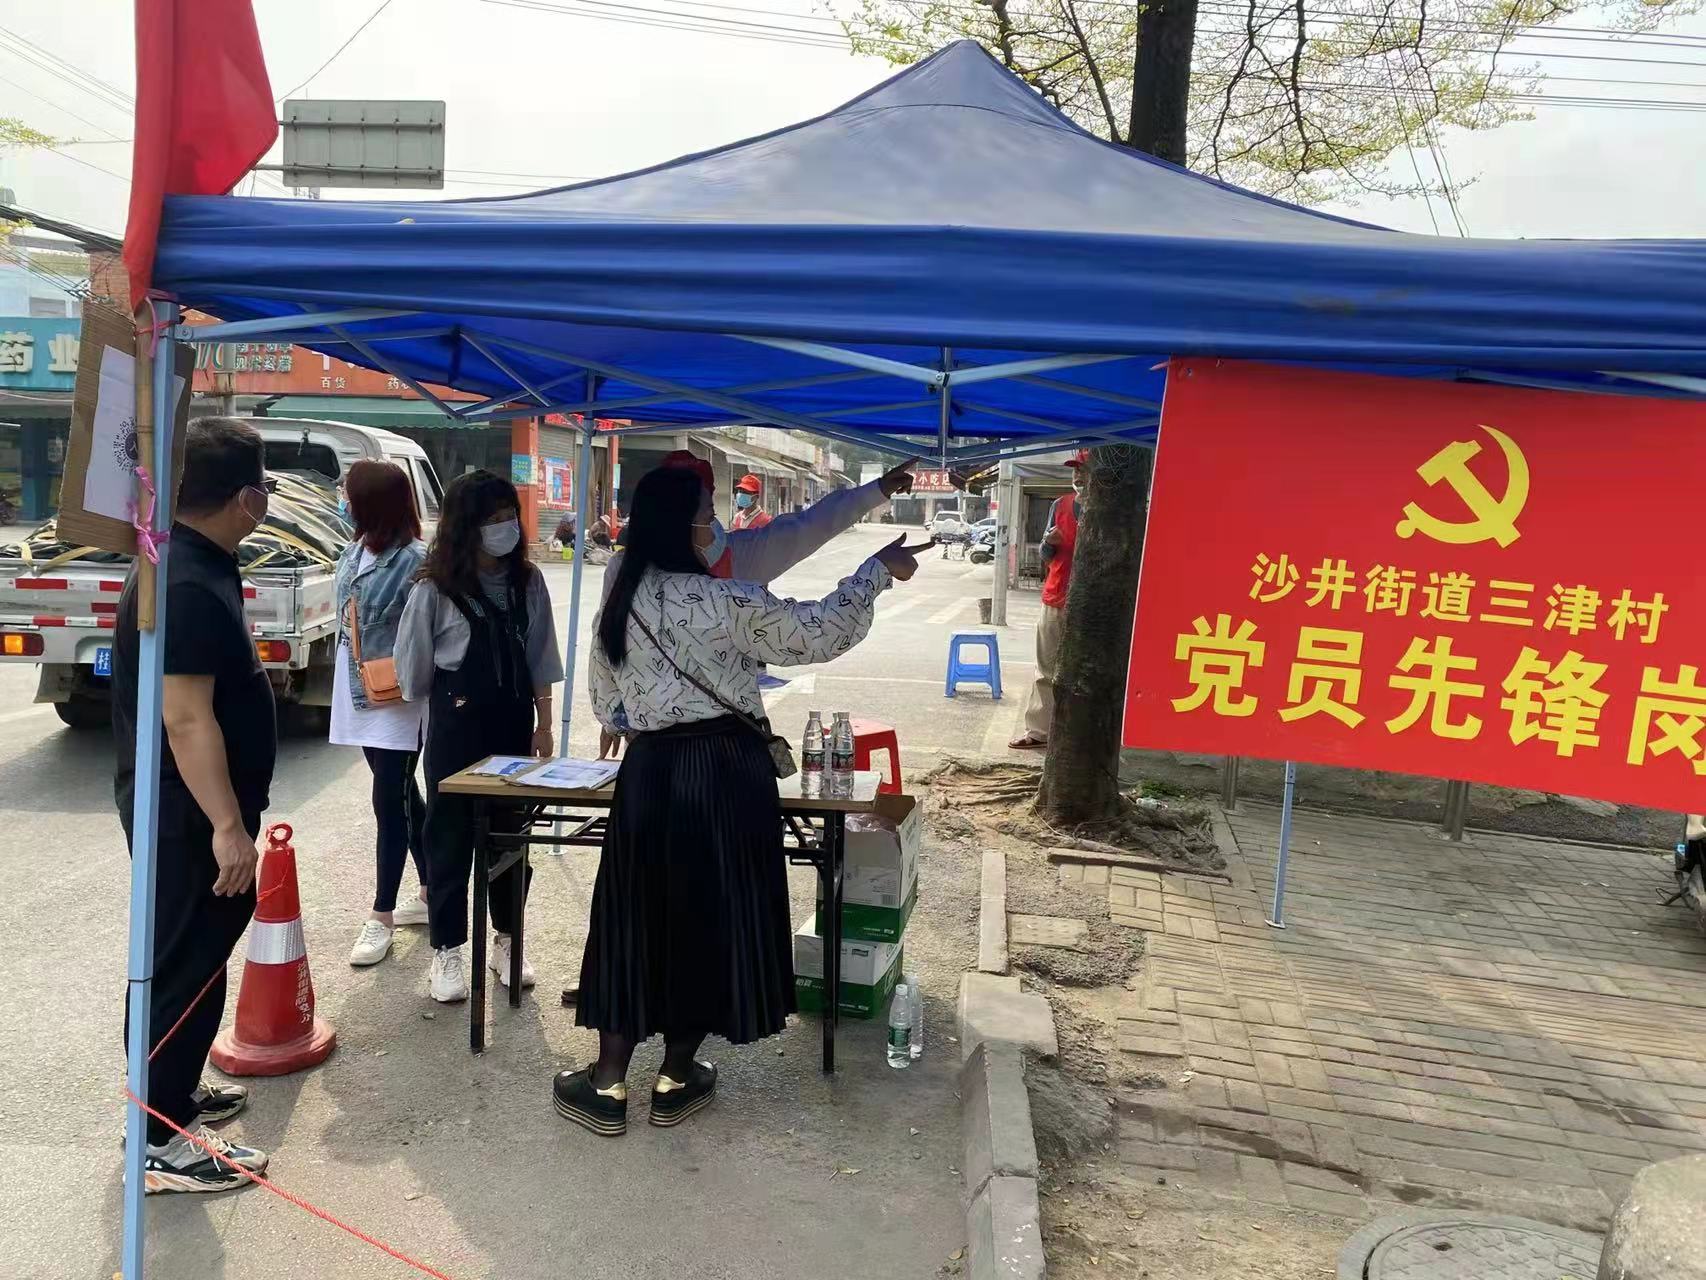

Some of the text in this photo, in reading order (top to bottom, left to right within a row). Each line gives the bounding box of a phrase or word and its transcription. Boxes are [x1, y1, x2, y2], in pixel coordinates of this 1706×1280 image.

[0, 331, 80, 372] 药业
[320, 377, 346, 389] 百货
[1248, 552, 1669, 644] 沙井街道三津村
[1170, 613, 1706, 776] 党员先锋岗
